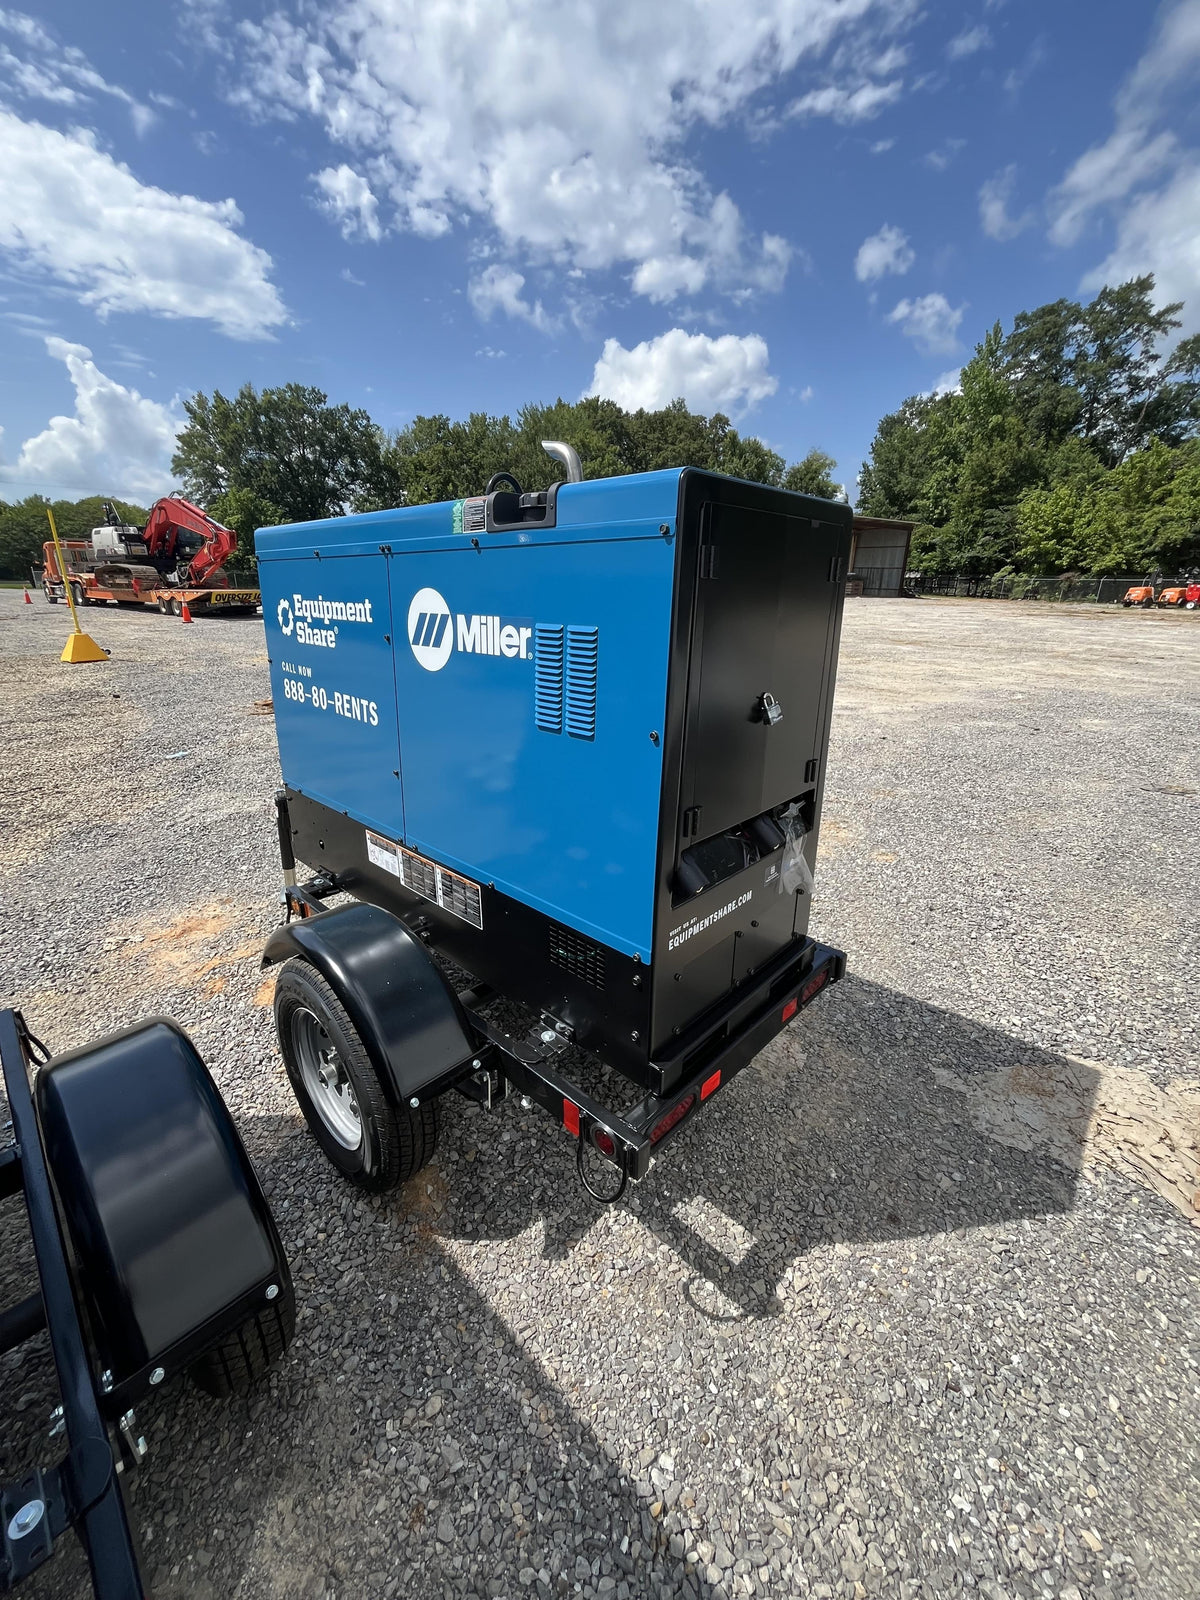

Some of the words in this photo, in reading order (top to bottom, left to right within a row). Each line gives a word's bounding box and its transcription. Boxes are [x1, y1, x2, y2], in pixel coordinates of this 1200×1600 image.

[215, 593, 253, 602] OVERSIZE
[293, 594, 373, 625] Equipment
[296, 621, 337, 649] Share
[456, 614, 532, 660] Miller
[281, 661, 297, 674] CALL
[298, 665, 312, 678] NOW
[283, 678, 379, 726] 888-80-RENTS
[668, 889, 753, 951] EQUIPMENTSHARE.COM
